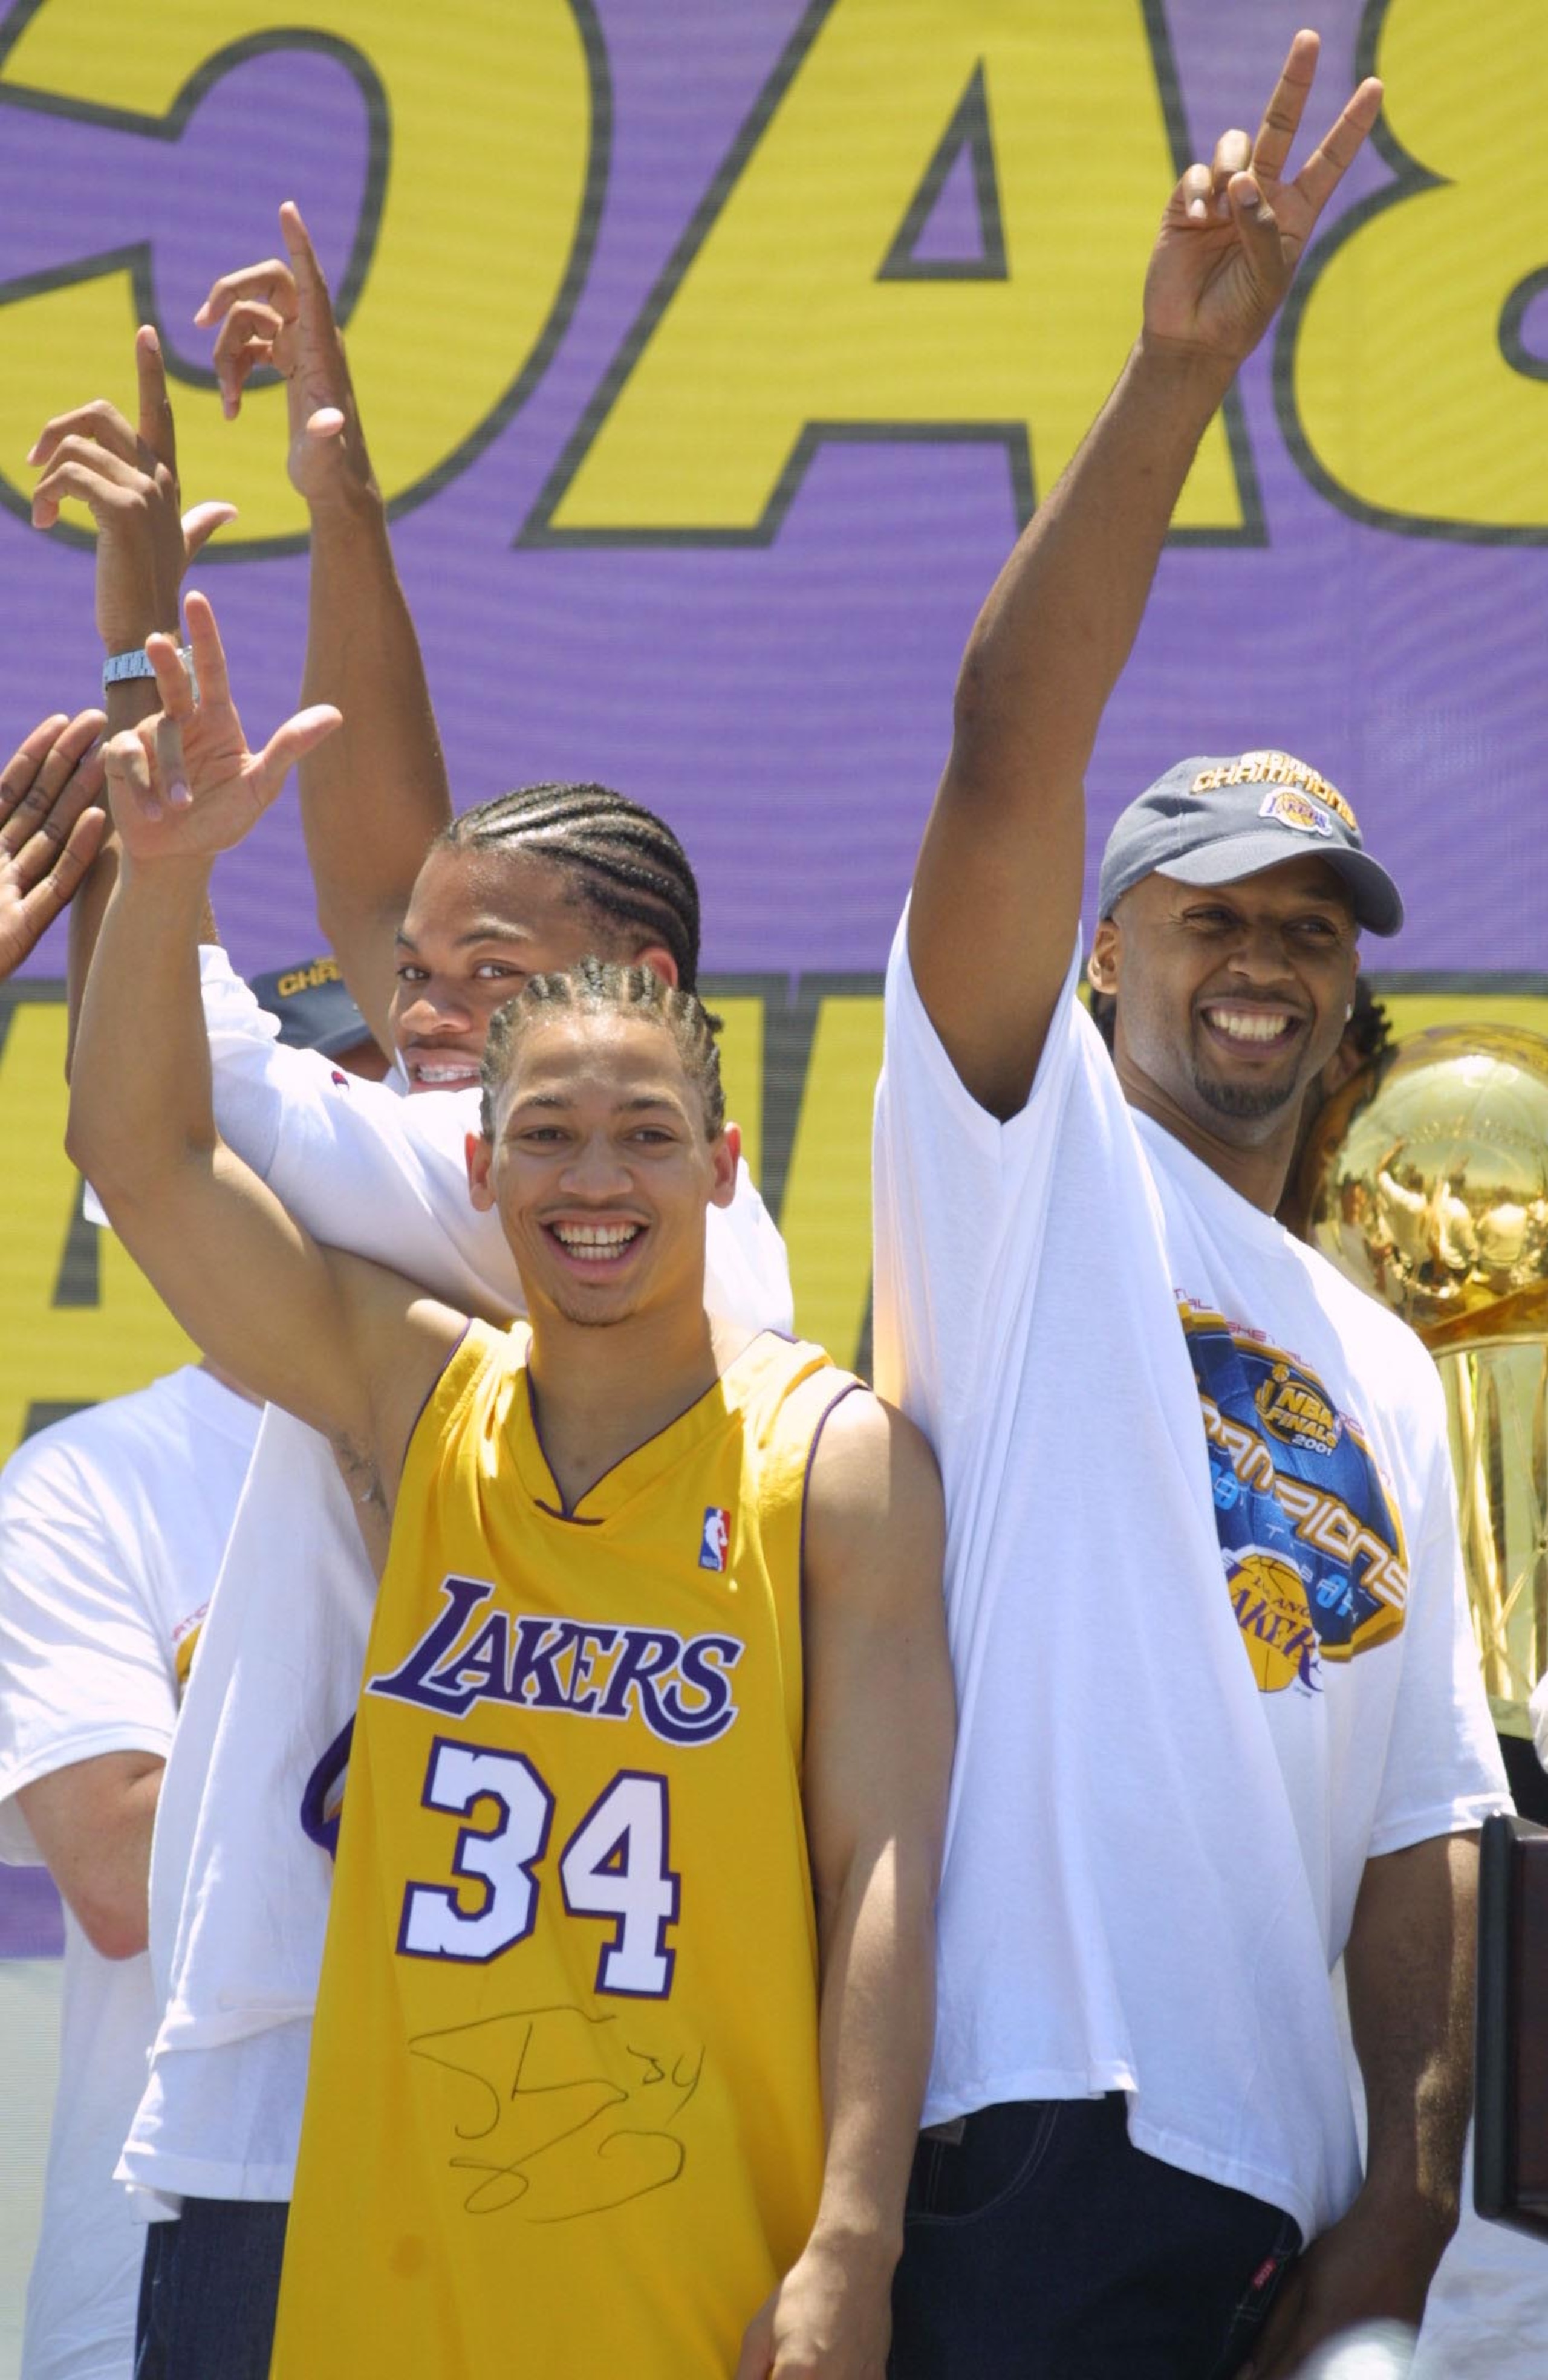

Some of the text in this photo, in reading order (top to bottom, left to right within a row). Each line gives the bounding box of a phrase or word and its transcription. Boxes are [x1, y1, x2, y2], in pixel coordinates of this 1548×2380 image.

[1266, 1406, 1338, 1449] FINALS
[1276, 1387, 1334, 1433] NBA
[365, 1573, 746, 1748] LAKERS
[395, 1734, 682, 2001] 34
